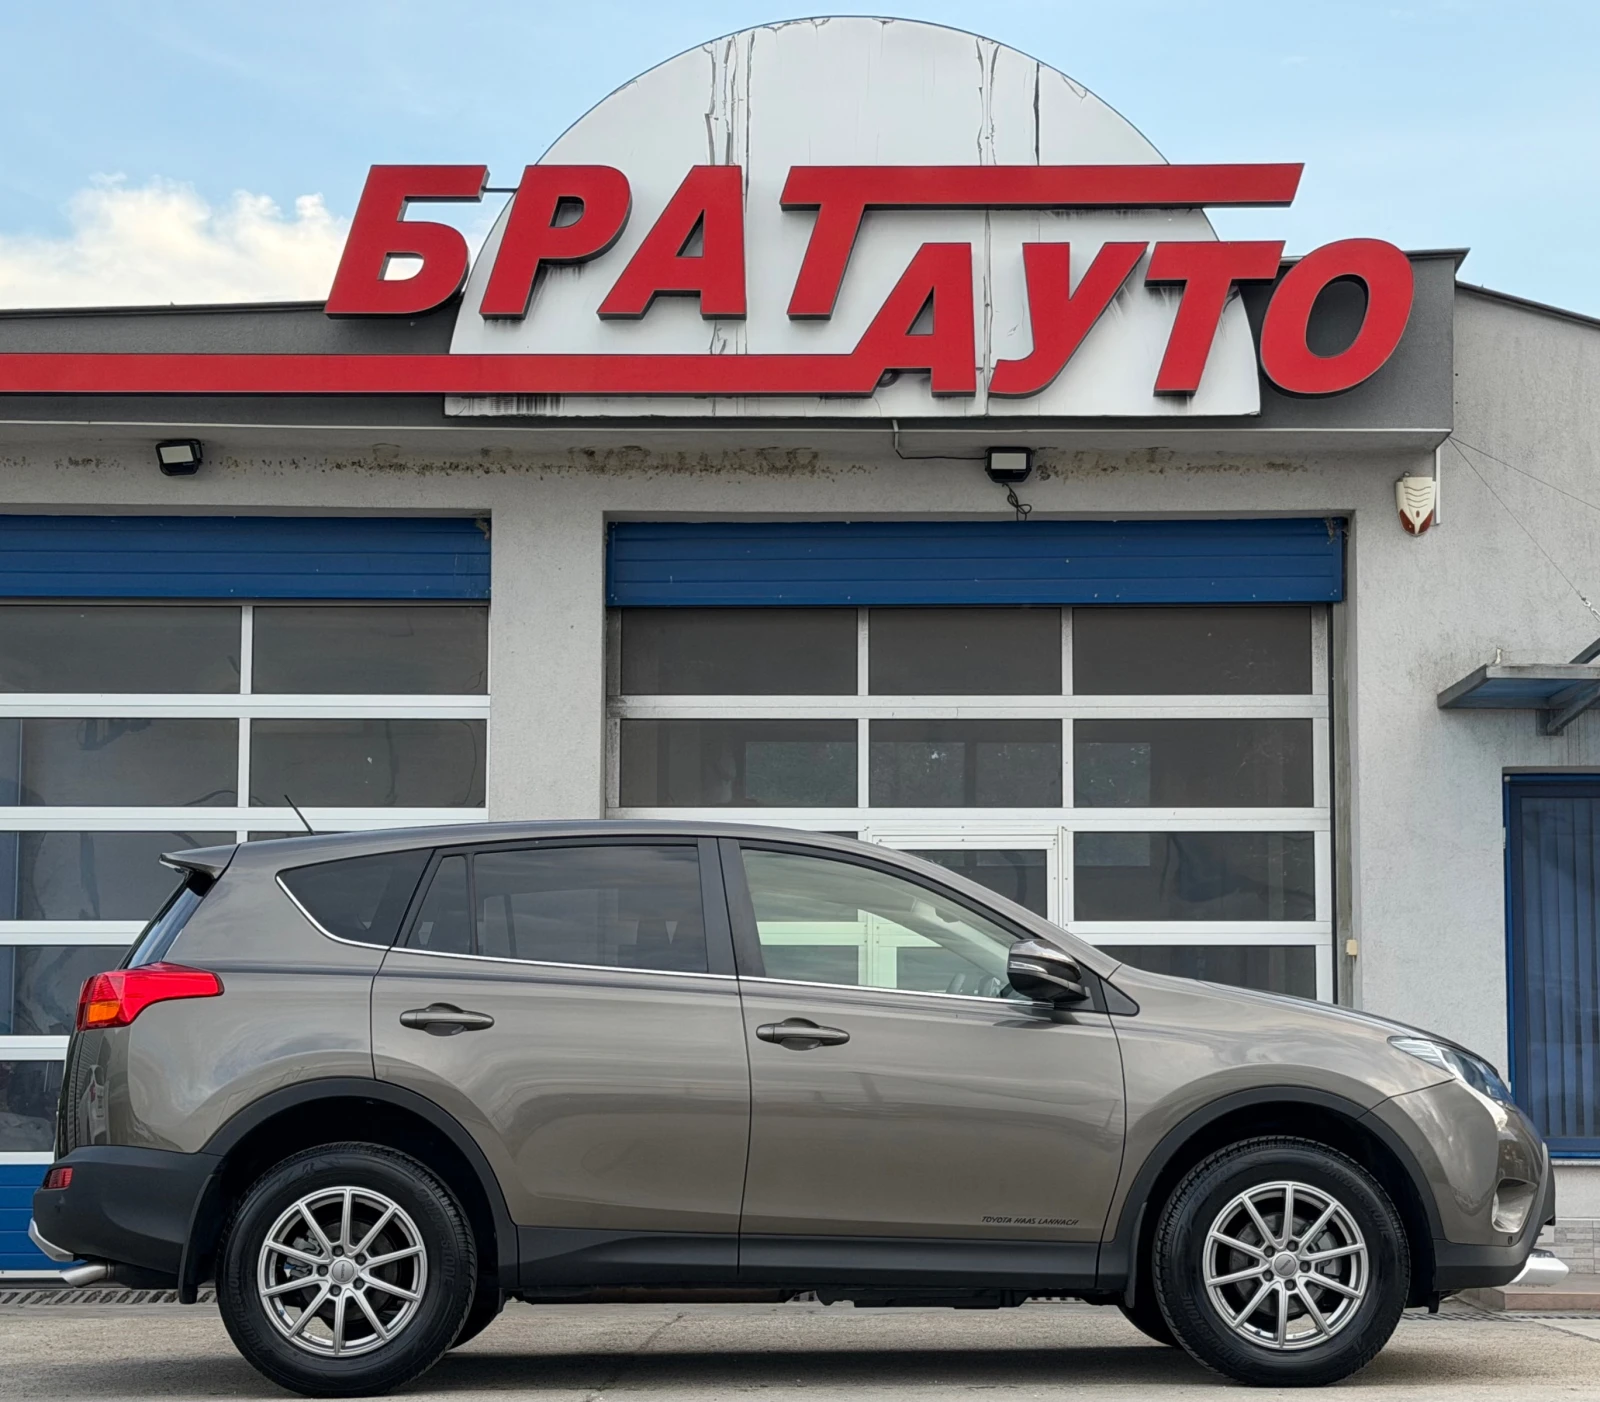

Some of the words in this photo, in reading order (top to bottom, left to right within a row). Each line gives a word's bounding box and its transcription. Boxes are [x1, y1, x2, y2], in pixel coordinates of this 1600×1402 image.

[325, 163, 1304, 322] БРАТ
[981, 1215, 1012, 1224] TOYOTA
[1014, 1217, 1036, 1225] HAAS
[1037, 1218, 1079, 1226] LANNACH
